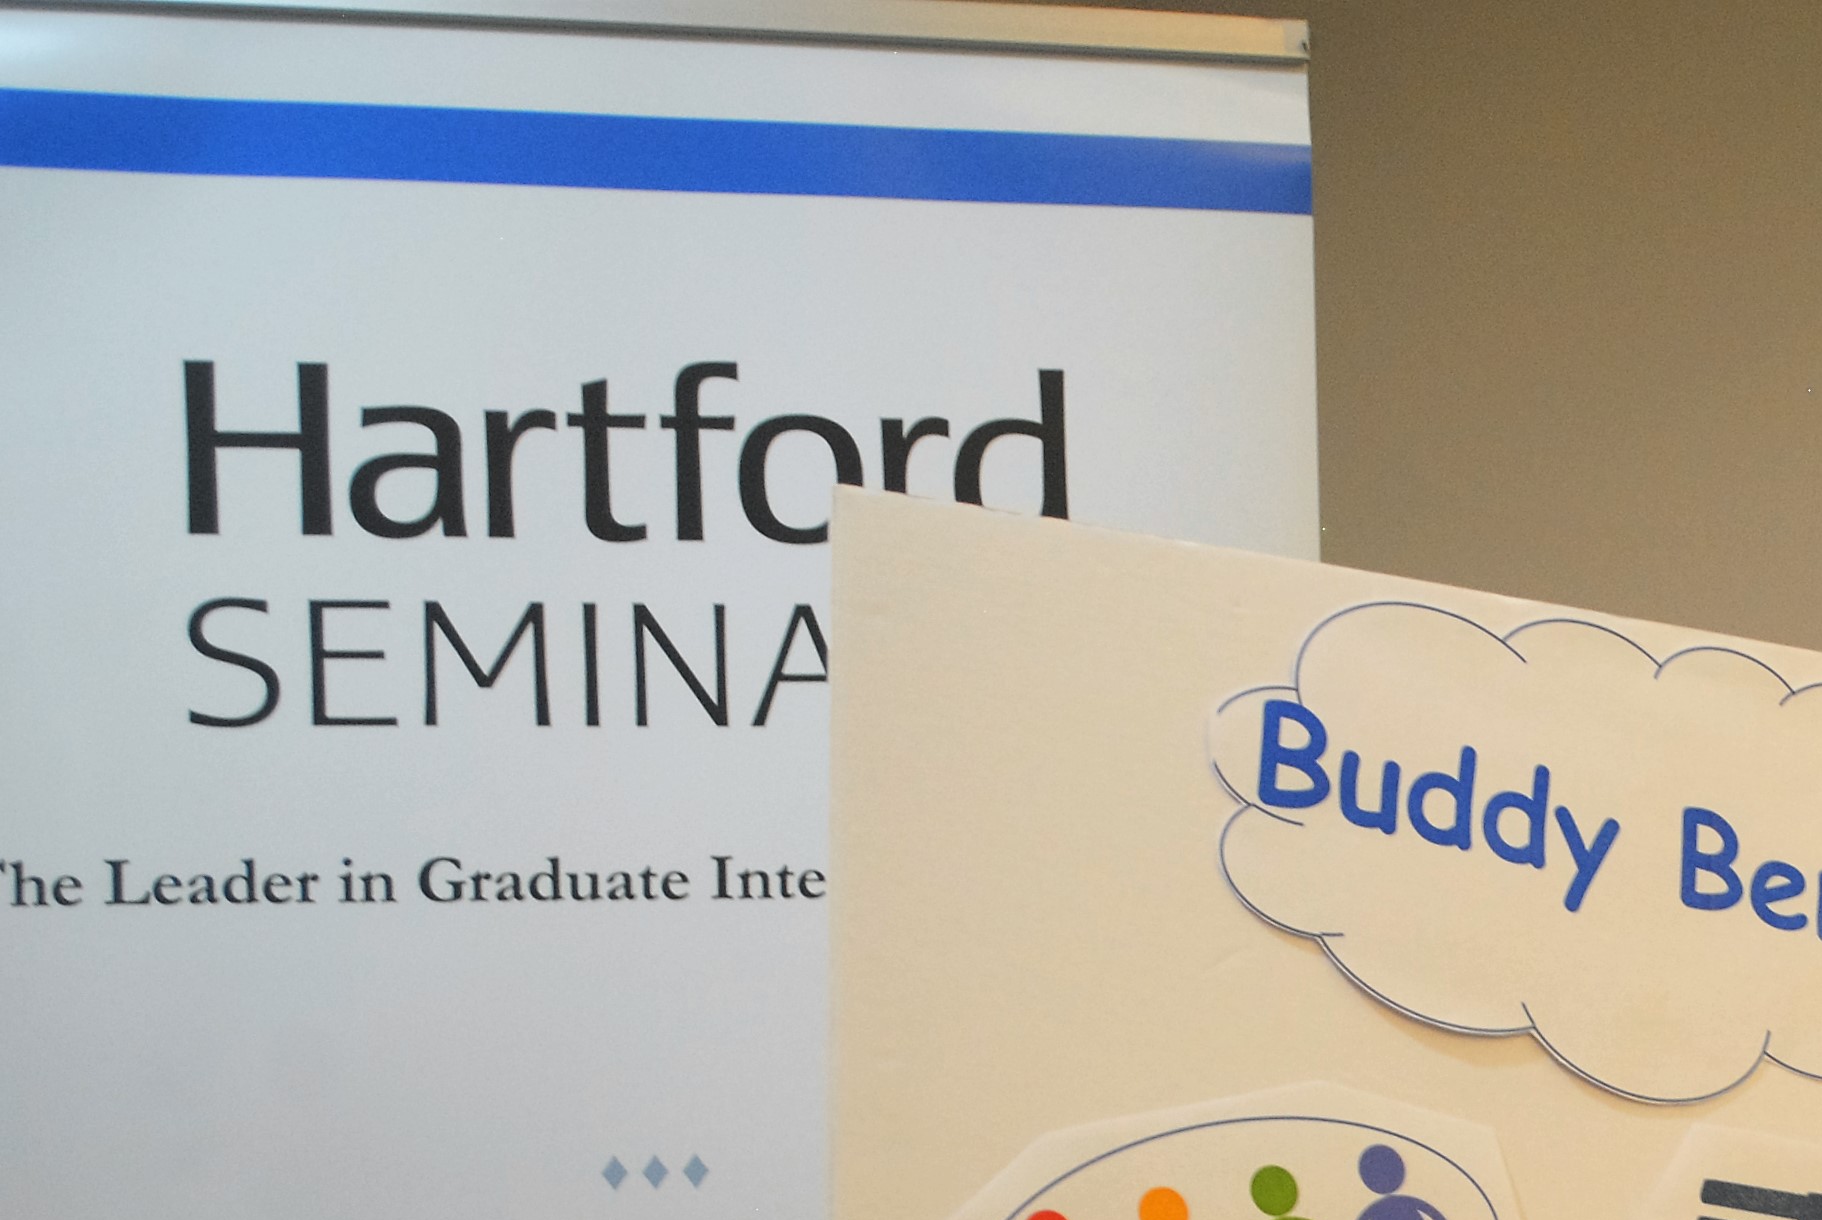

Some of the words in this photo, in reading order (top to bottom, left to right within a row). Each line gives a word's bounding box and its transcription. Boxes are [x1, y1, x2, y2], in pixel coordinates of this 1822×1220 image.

[183, 358, 1069, 544] Hartford
[187, 597, 829, 728] SEMINA
[0, 858, 84, 907] he
[104, 857, 319, 906] Leader
[338, 857, 397, 904] in
[417, 856, 690, 903] Graduate
[710, 855, 827, 900] Inte
[1257, 699, 1621, 912] Buddy
